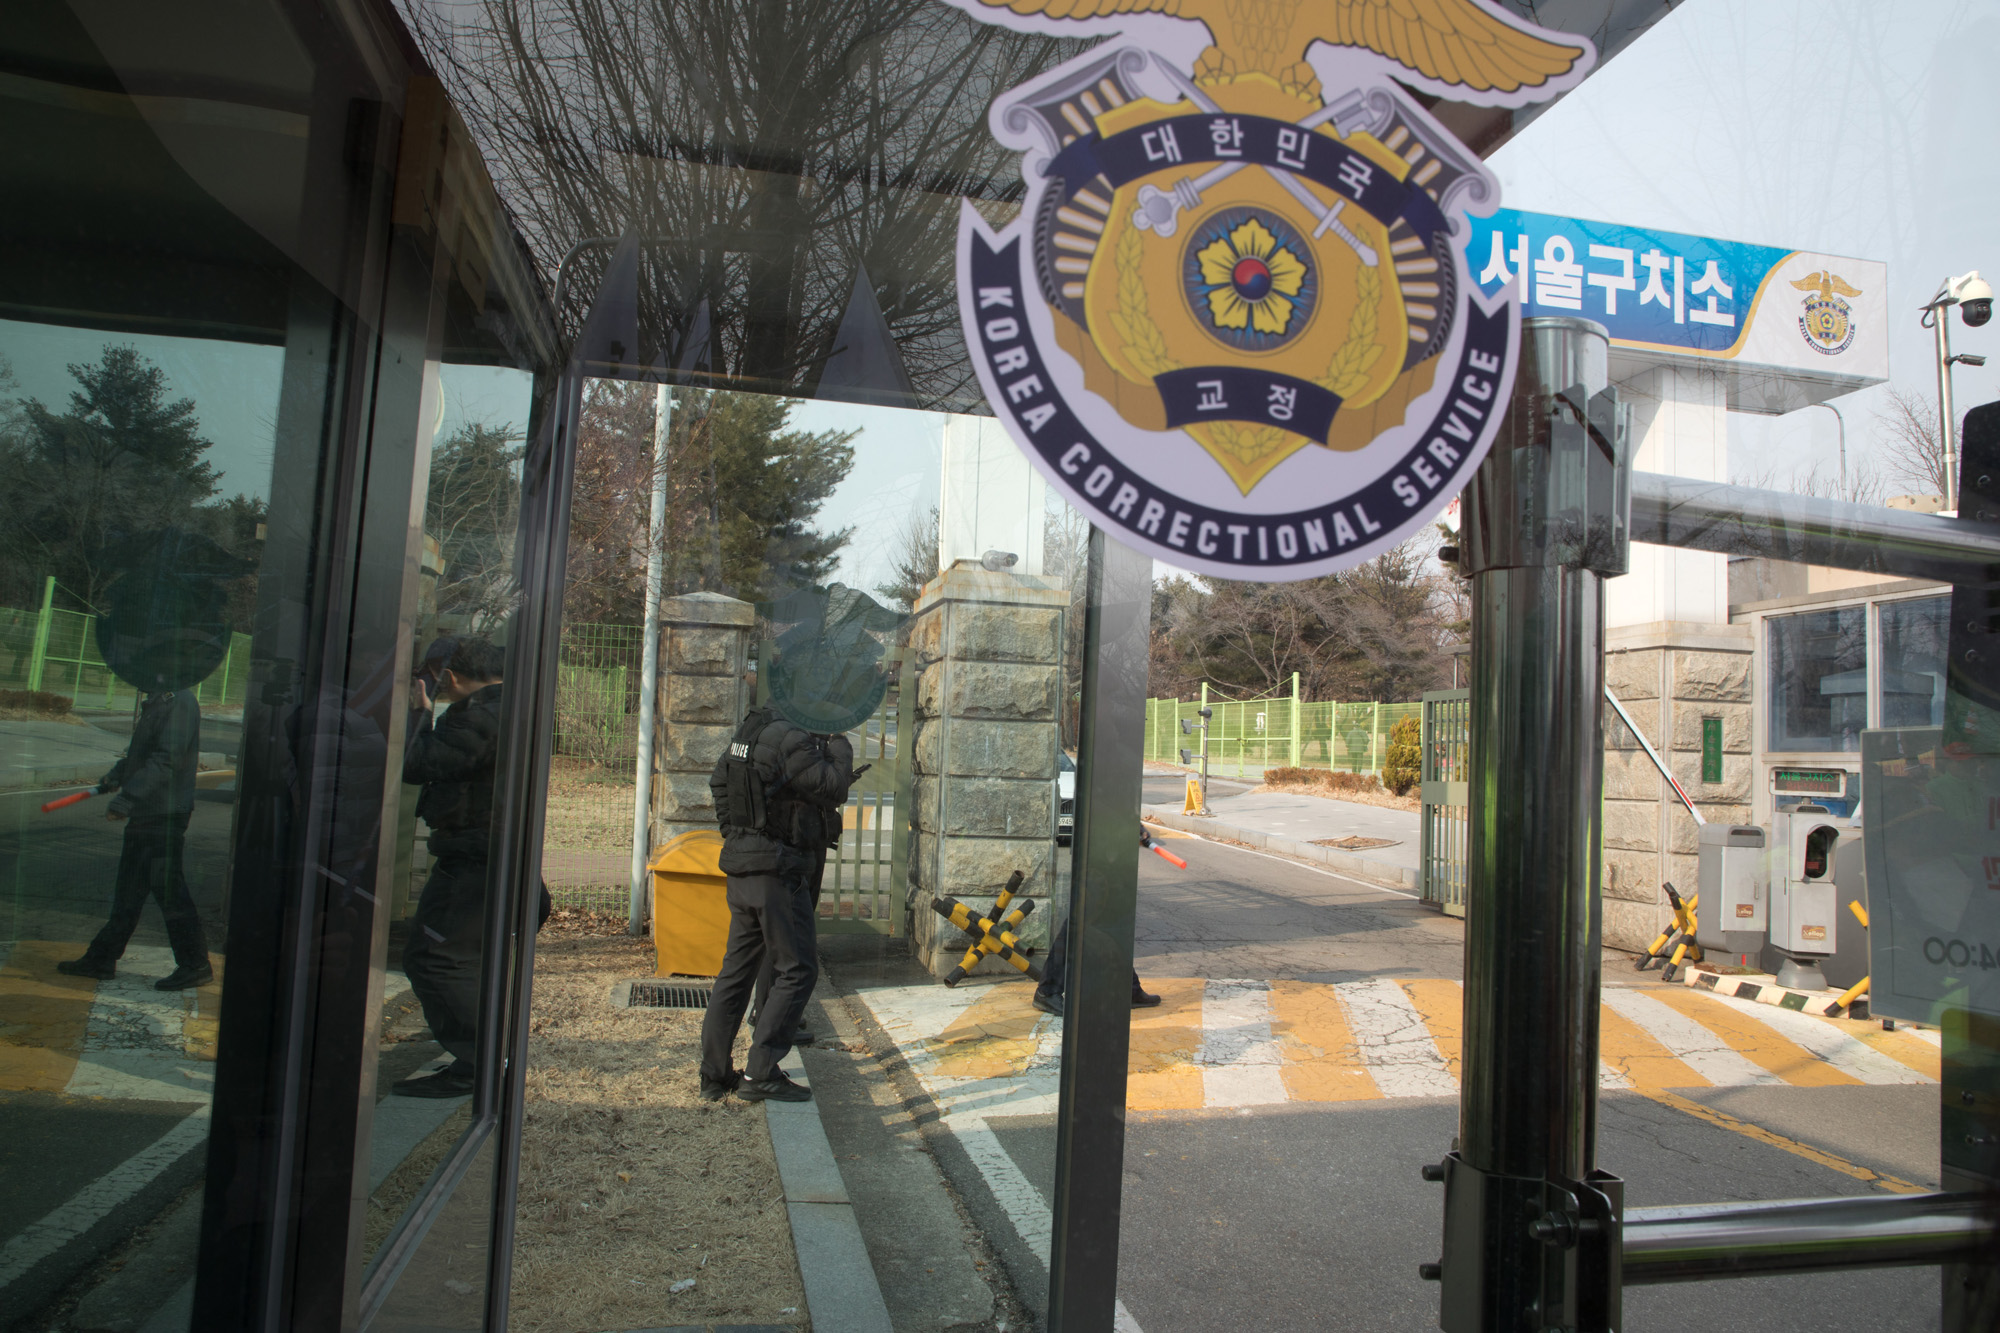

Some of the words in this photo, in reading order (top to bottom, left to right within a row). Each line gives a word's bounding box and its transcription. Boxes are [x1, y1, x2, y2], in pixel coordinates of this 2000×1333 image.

[1142, 118, 1374, 199] 대한민국
[1480, 230, 1736, 328] 서울구치소
[978, 286, 1057, 434] KOREA
[1059, 442, 1382, 561] CORRECTIONAL
[1392, 347, 1499, 508] SERVICE
[1197, 380, 1297, 421] 교정
